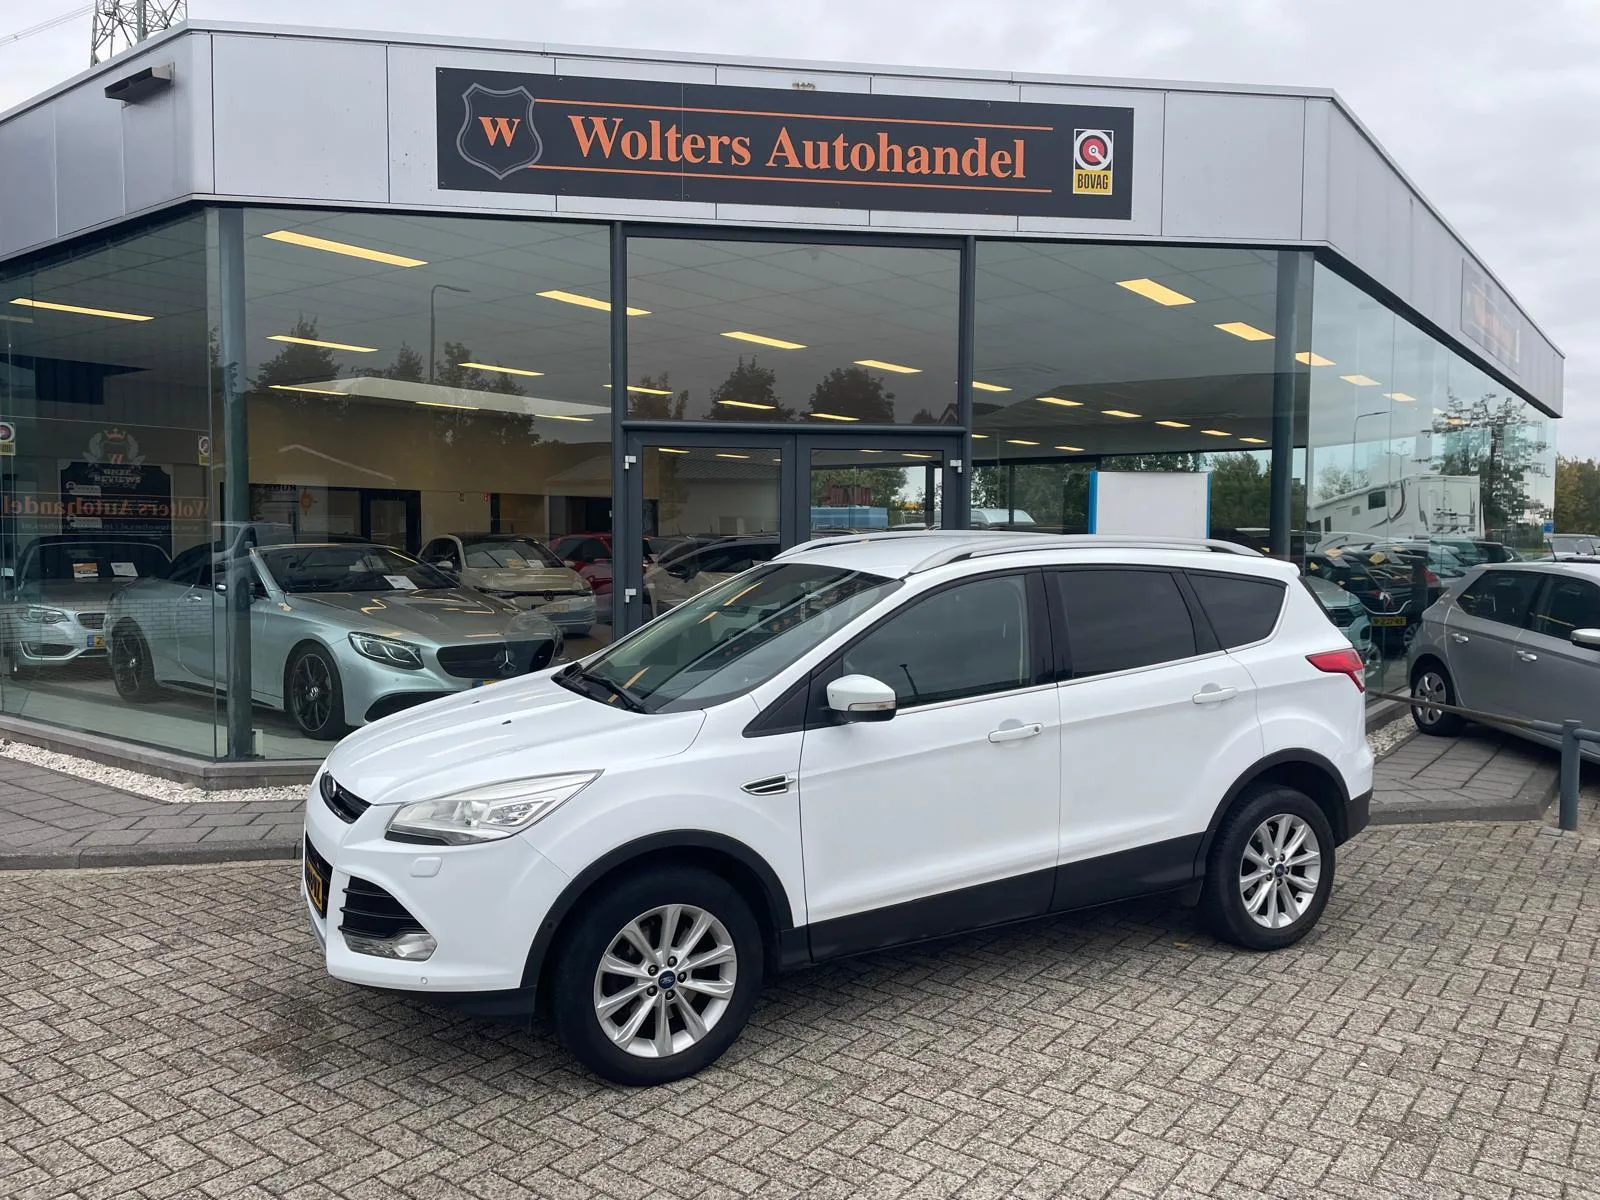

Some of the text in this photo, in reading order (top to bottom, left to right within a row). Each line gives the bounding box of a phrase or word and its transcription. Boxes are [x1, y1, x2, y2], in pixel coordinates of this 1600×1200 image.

[479, 116, 520, 147] W
[568, 115, 1026, 178] Wolters Autohandel
[1077, 173, 1108, 190] BOVAG
